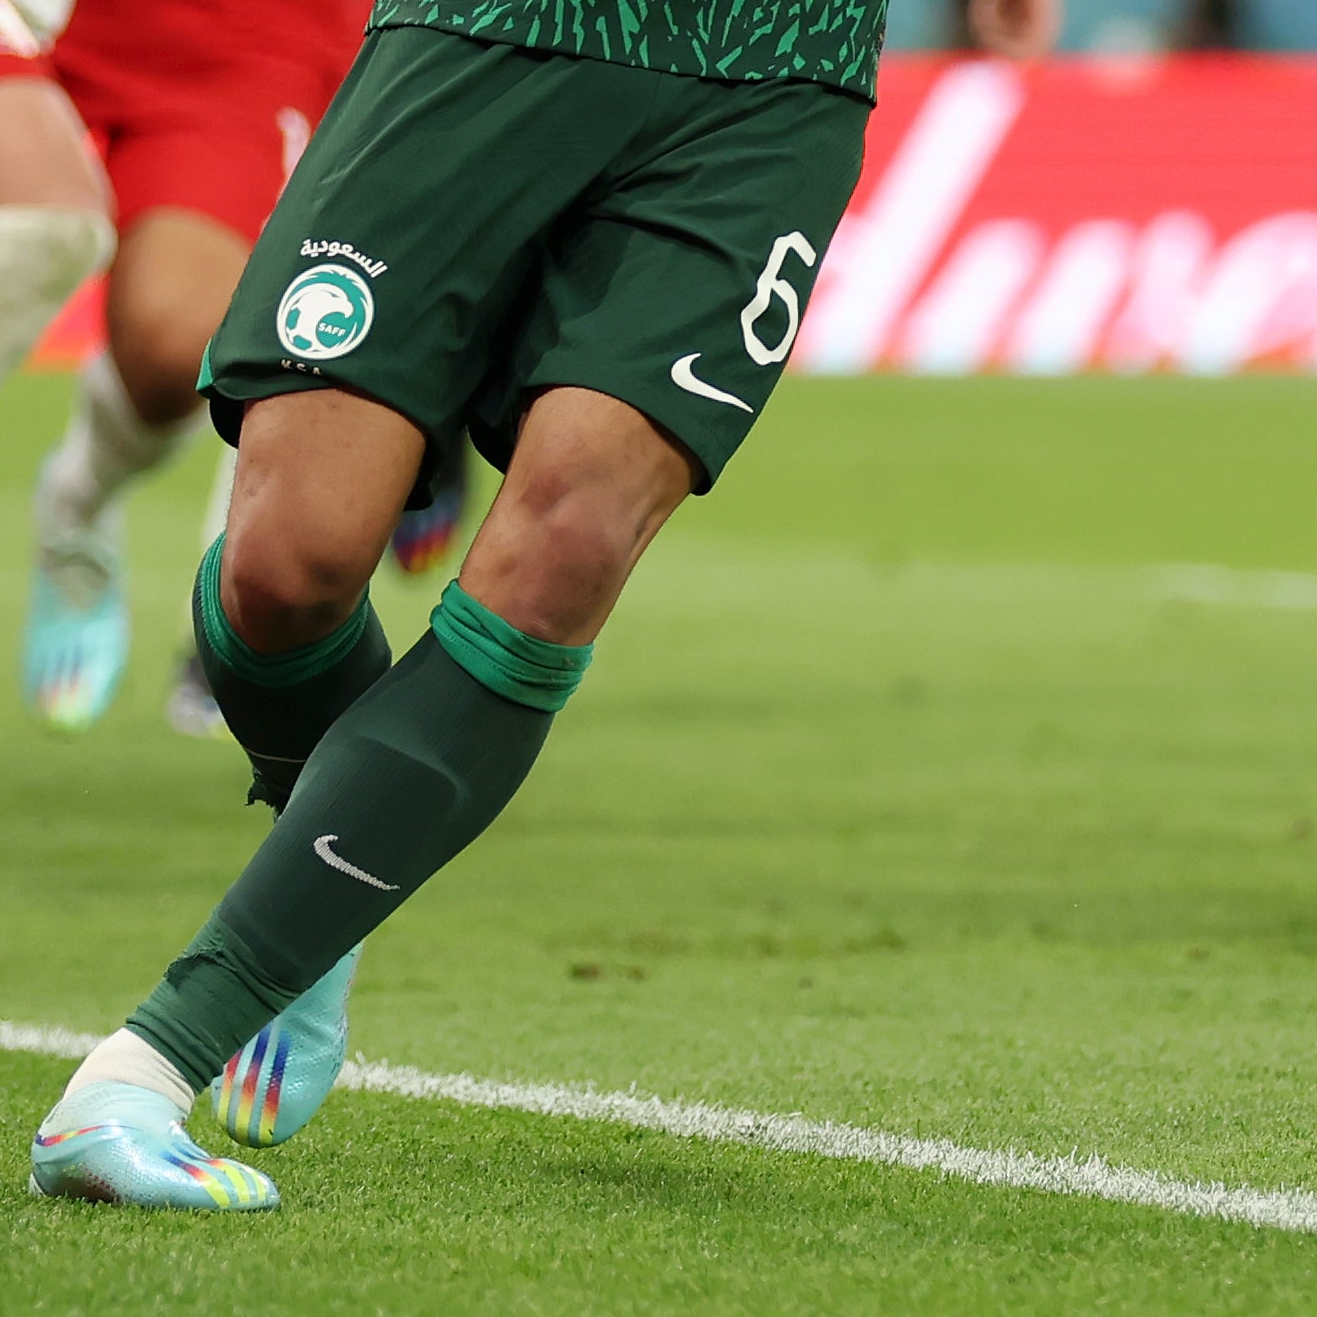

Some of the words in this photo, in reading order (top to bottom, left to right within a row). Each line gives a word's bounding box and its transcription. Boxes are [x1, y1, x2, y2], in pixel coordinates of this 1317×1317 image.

[300, 239, 388, 278] السعودية
[740, 231, 817, 366] 6
[318, 322, 347, 337] SAFF
